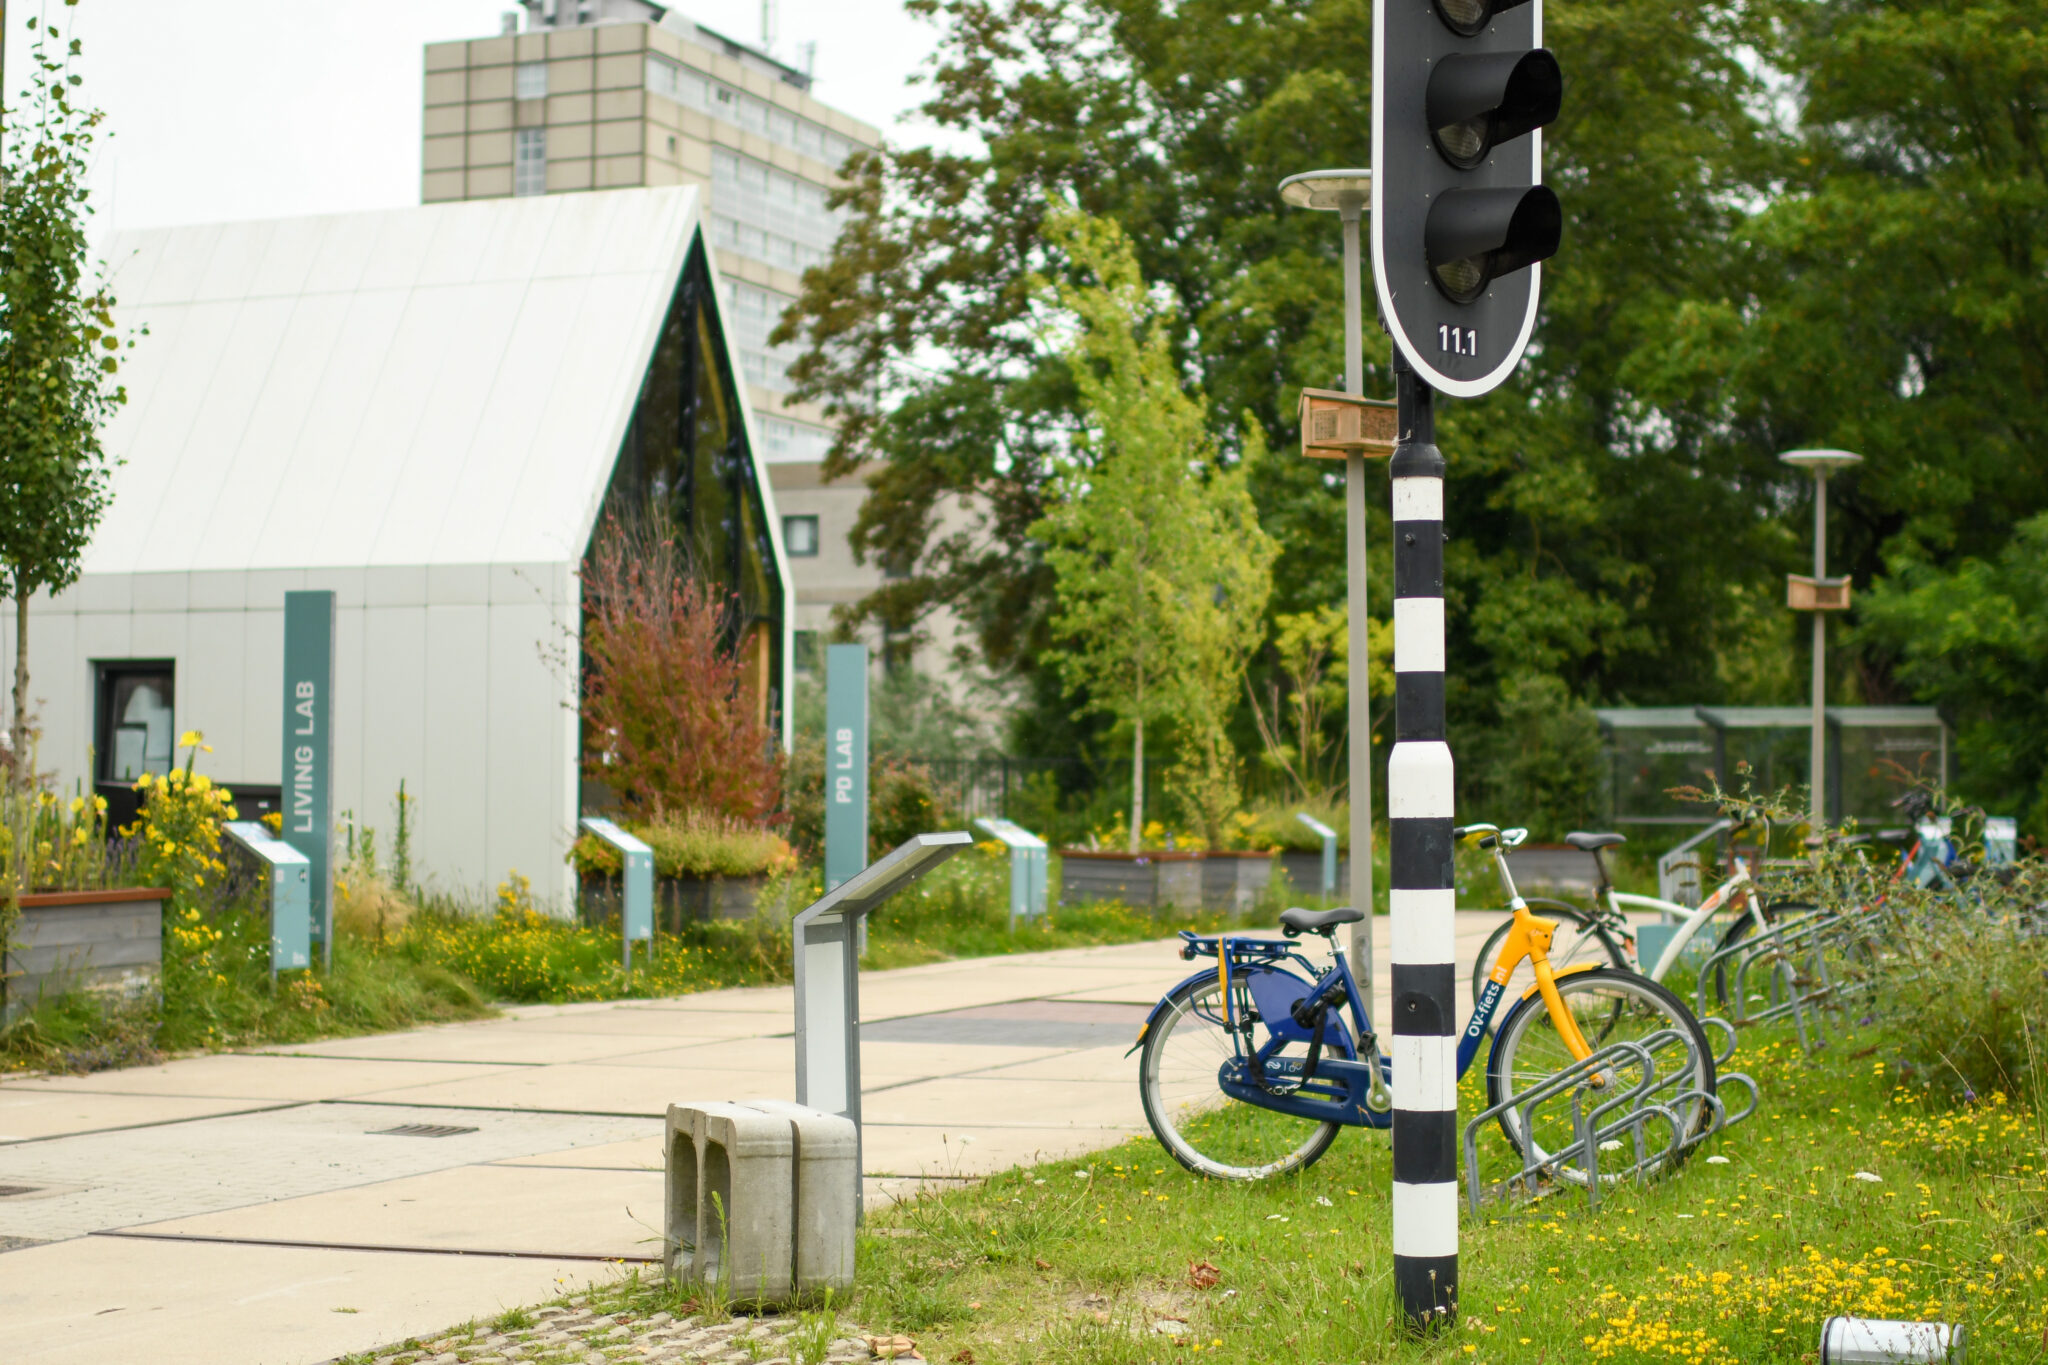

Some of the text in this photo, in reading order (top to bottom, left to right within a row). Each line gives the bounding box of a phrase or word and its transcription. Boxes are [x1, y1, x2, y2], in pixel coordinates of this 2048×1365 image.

[1439, 324, 1476, 357] 11.1
[294, 680, 315, 833] LIVING LAB
[836, 728, 853, 804] PD LAB
[1468, 965, 1508, 1037] OV-fiets.nl
